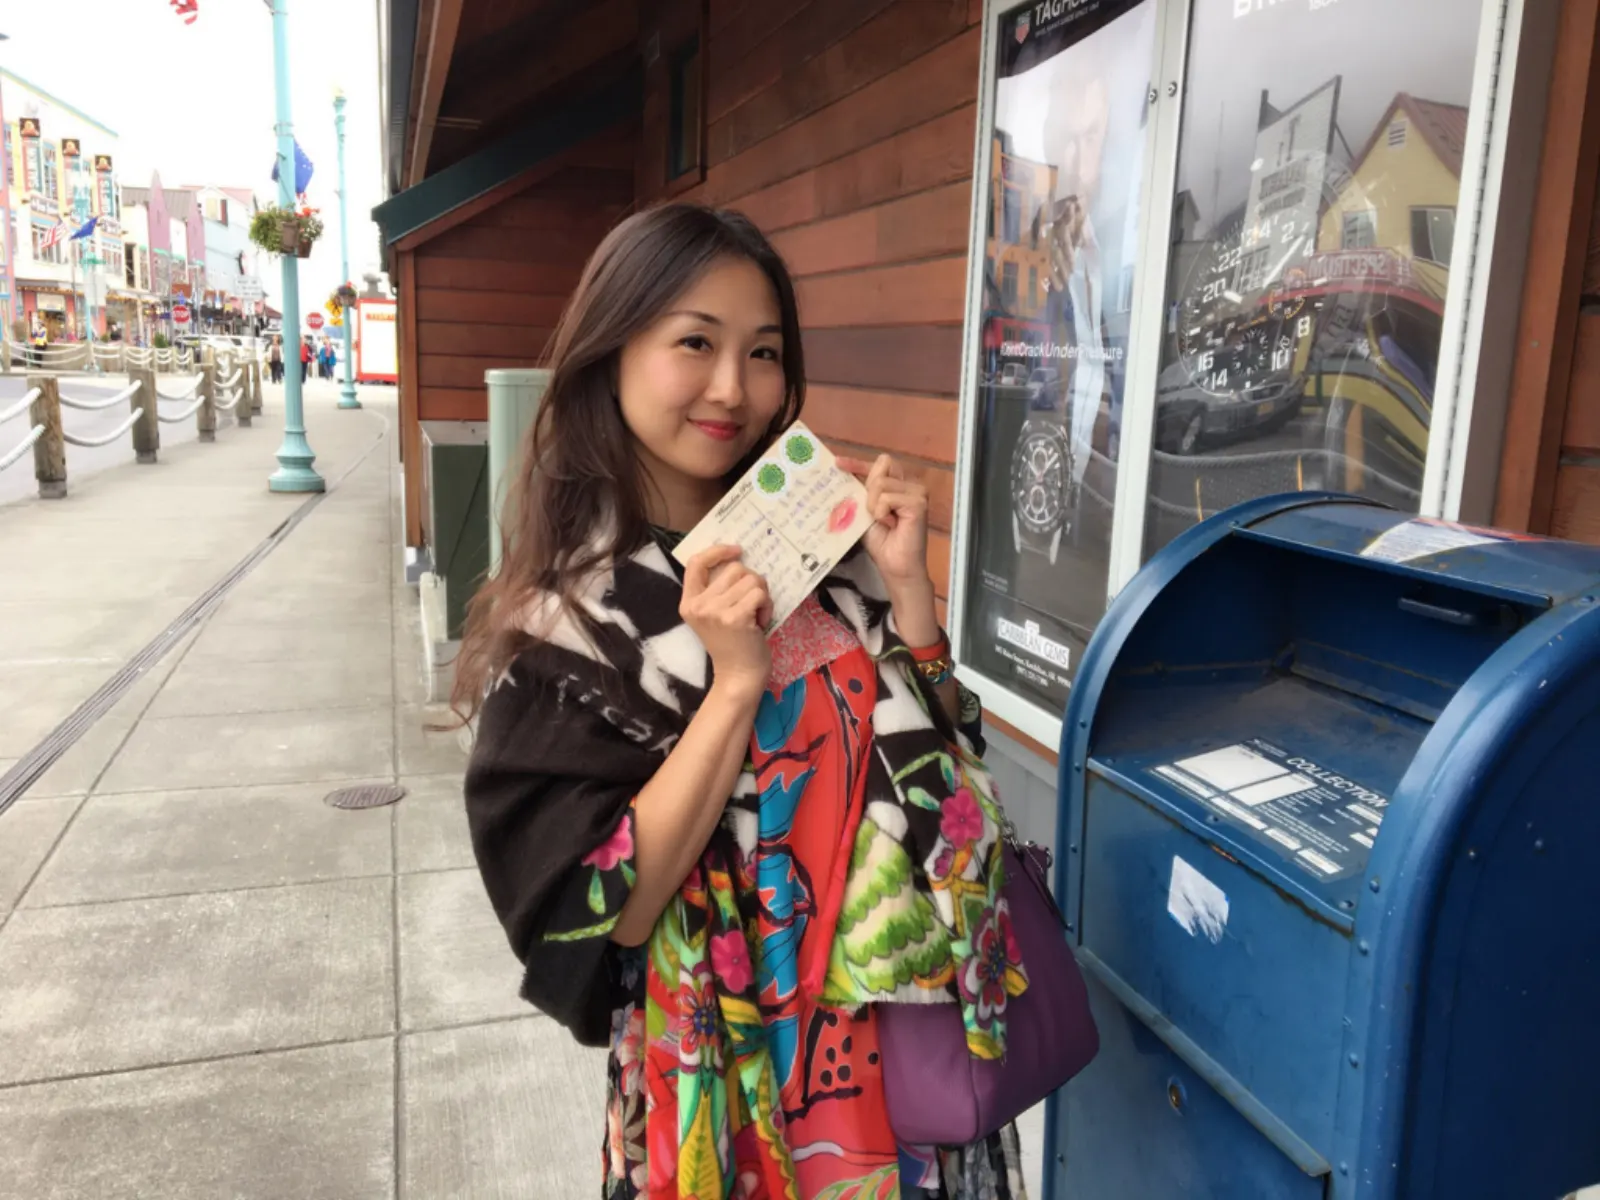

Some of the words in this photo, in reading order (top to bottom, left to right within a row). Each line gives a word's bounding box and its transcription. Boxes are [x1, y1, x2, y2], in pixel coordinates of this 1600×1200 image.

[1218, 247, 1242, 273] 22
[1202, 278, 1226, 304] 20
[1297, 316, 1311, 338] 8
[1197, 350, 1215, 373] 16
[1271, 349, 1289, 372] 10
[1211, 368, 1228, 390] 14
[1286, 757, 1389, 807] COLLECTION
